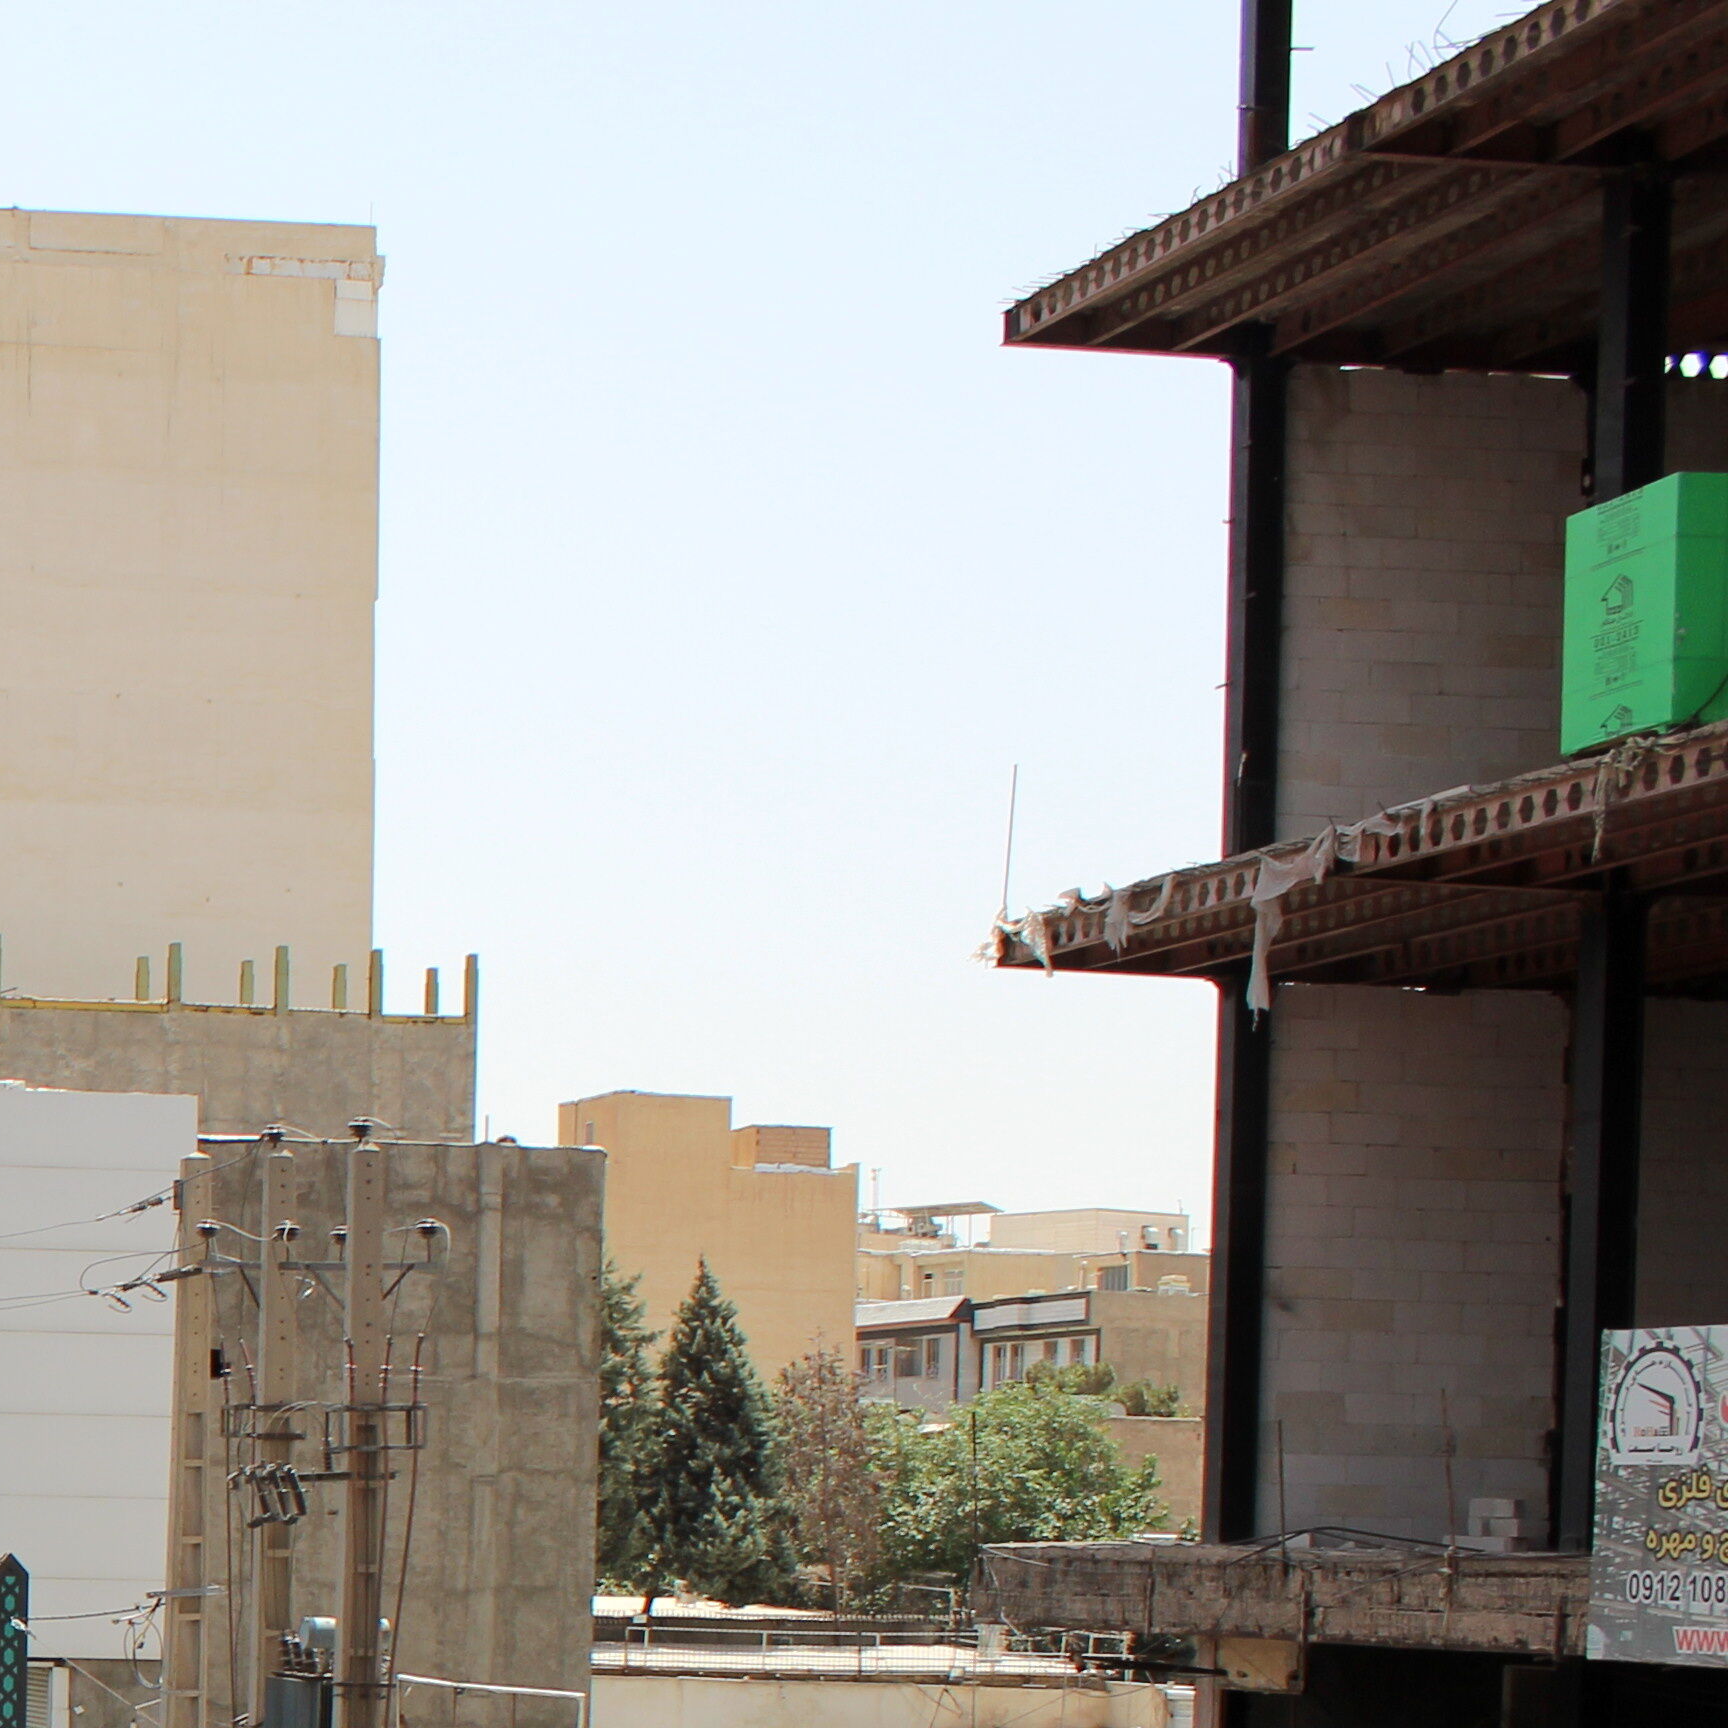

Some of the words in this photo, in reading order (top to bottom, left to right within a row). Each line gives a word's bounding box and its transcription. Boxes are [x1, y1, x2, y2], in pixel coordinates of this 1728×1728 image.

[1658, 1465, 1712, 1508] فلزی
[1646, 1529, 1697, 1560] مهره
[1628, 1573, 1681, 1602] 0912
